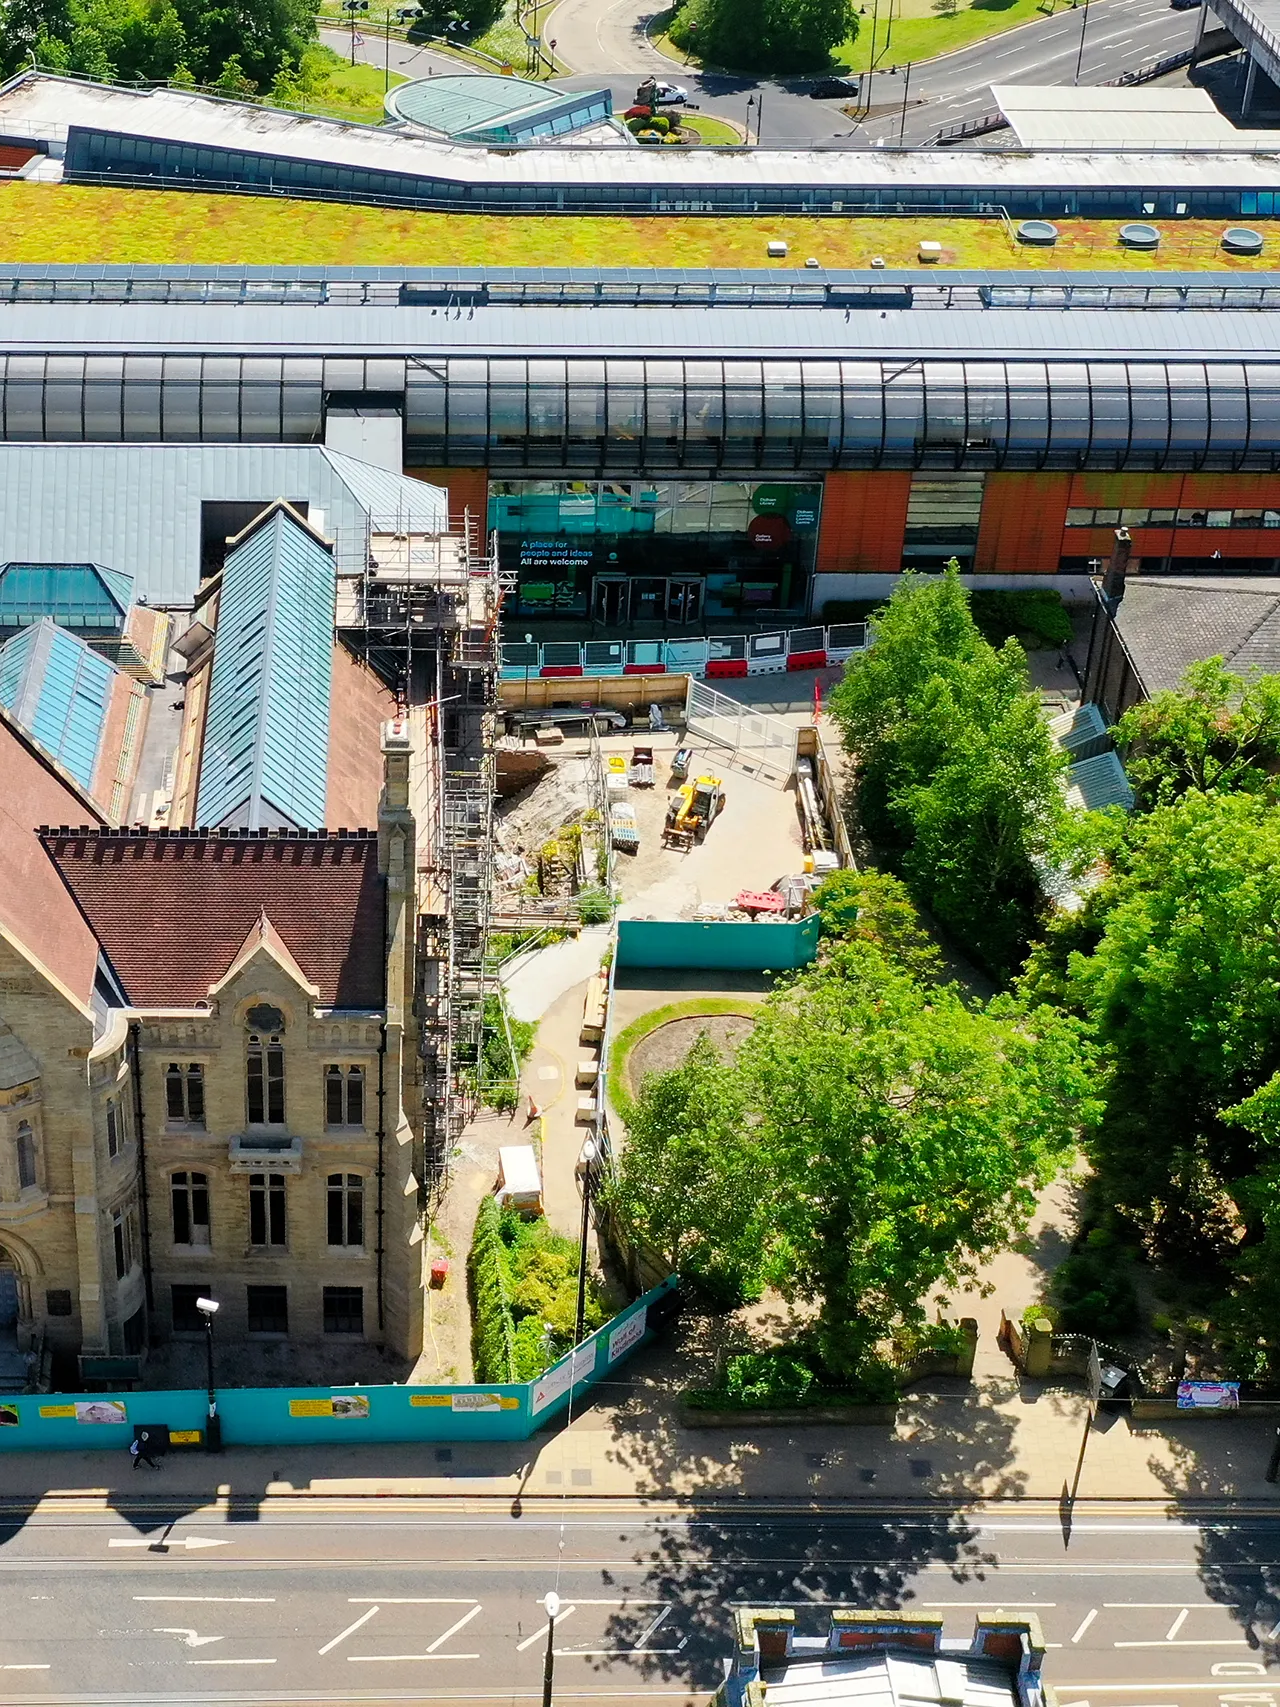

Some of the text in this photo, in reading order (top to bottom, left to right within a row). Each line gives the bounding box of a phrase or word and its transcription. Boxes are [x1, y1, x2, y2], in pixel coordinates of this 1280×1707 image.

[529, 541, 554, 549] place
[520, 550, 550, 558] people
[520, 558, 532, 566] All
[549, 558, 589, 566] welcome
[612, 1331, 628, 1348] Wall
[628, 1324, 637, 1336] of
[611, 1329, 642, 1359] Kindness
